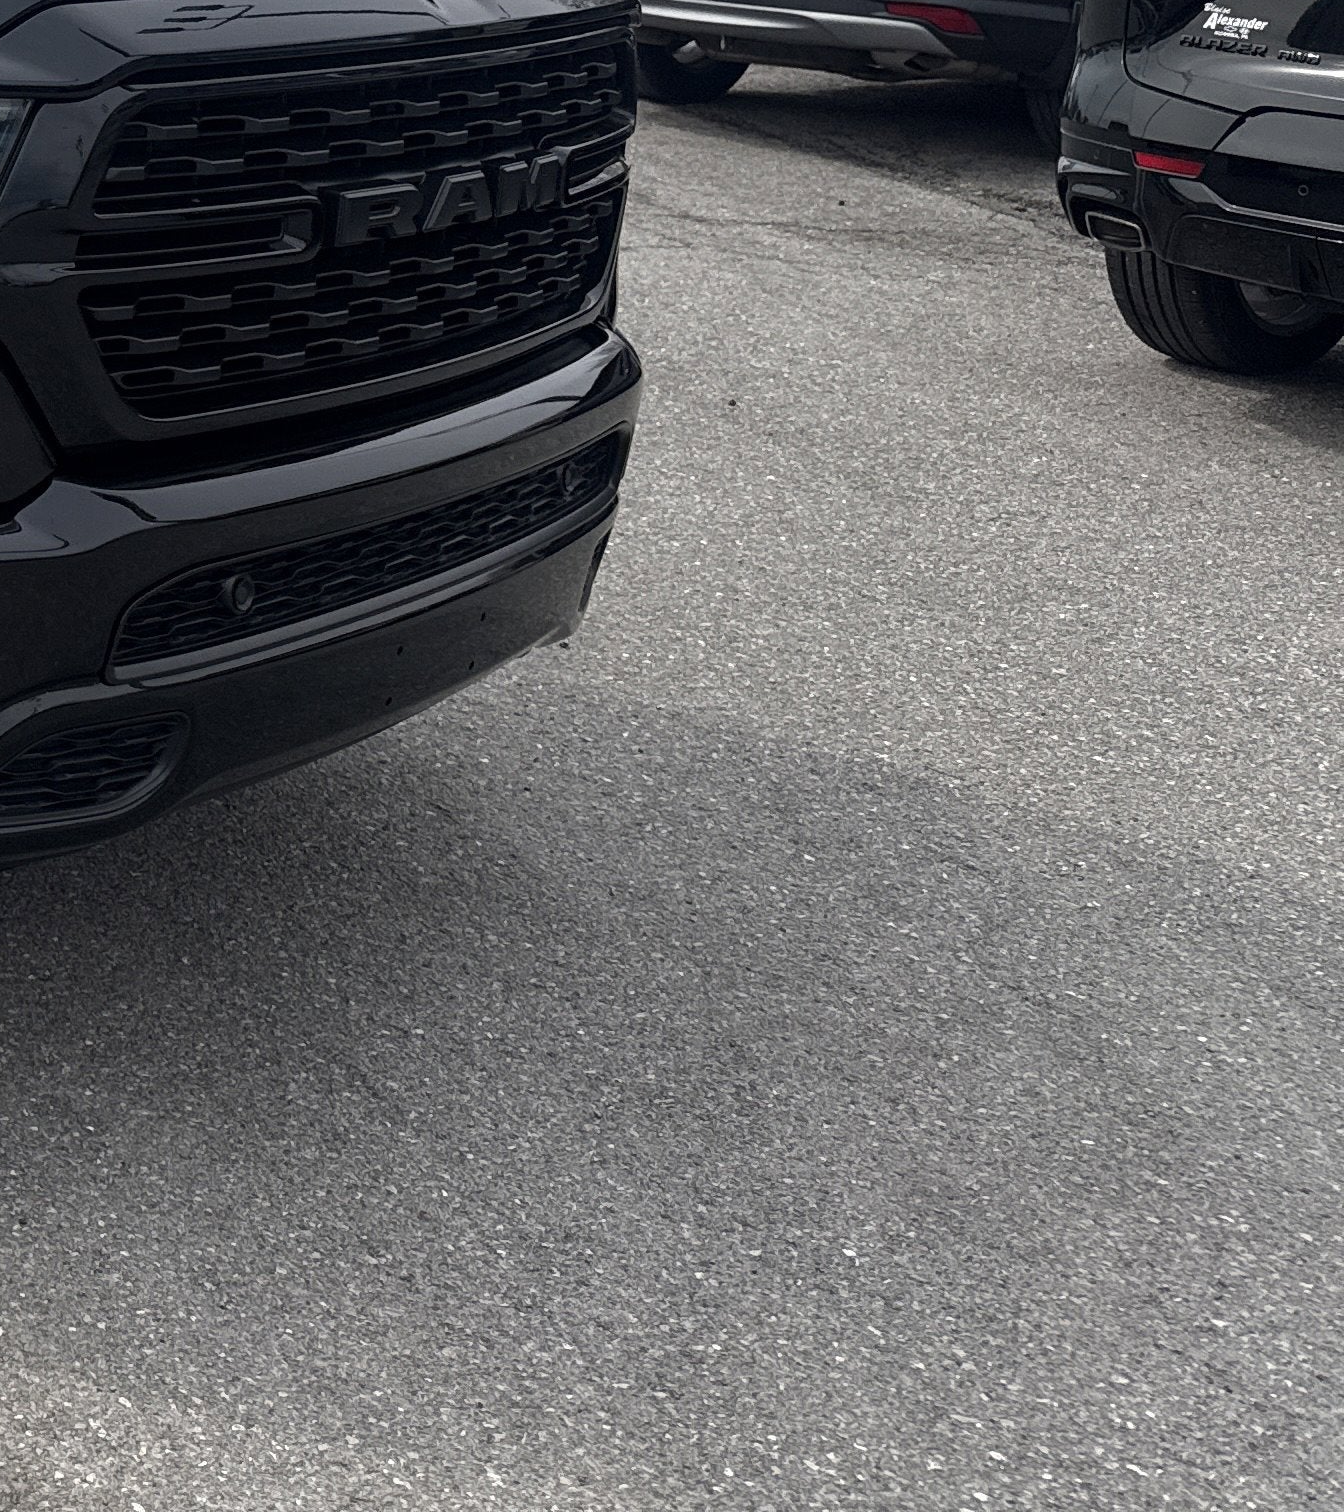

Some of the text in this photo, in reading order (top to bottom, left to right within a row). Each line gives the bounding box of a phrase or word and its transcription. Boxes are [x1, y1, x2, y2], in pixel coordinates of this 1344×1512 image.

[1203, 12, 1269, 31] Alexander
[1180, 34, 1268, 57] BLAZER
[336, 153, 561, 248] RAM
